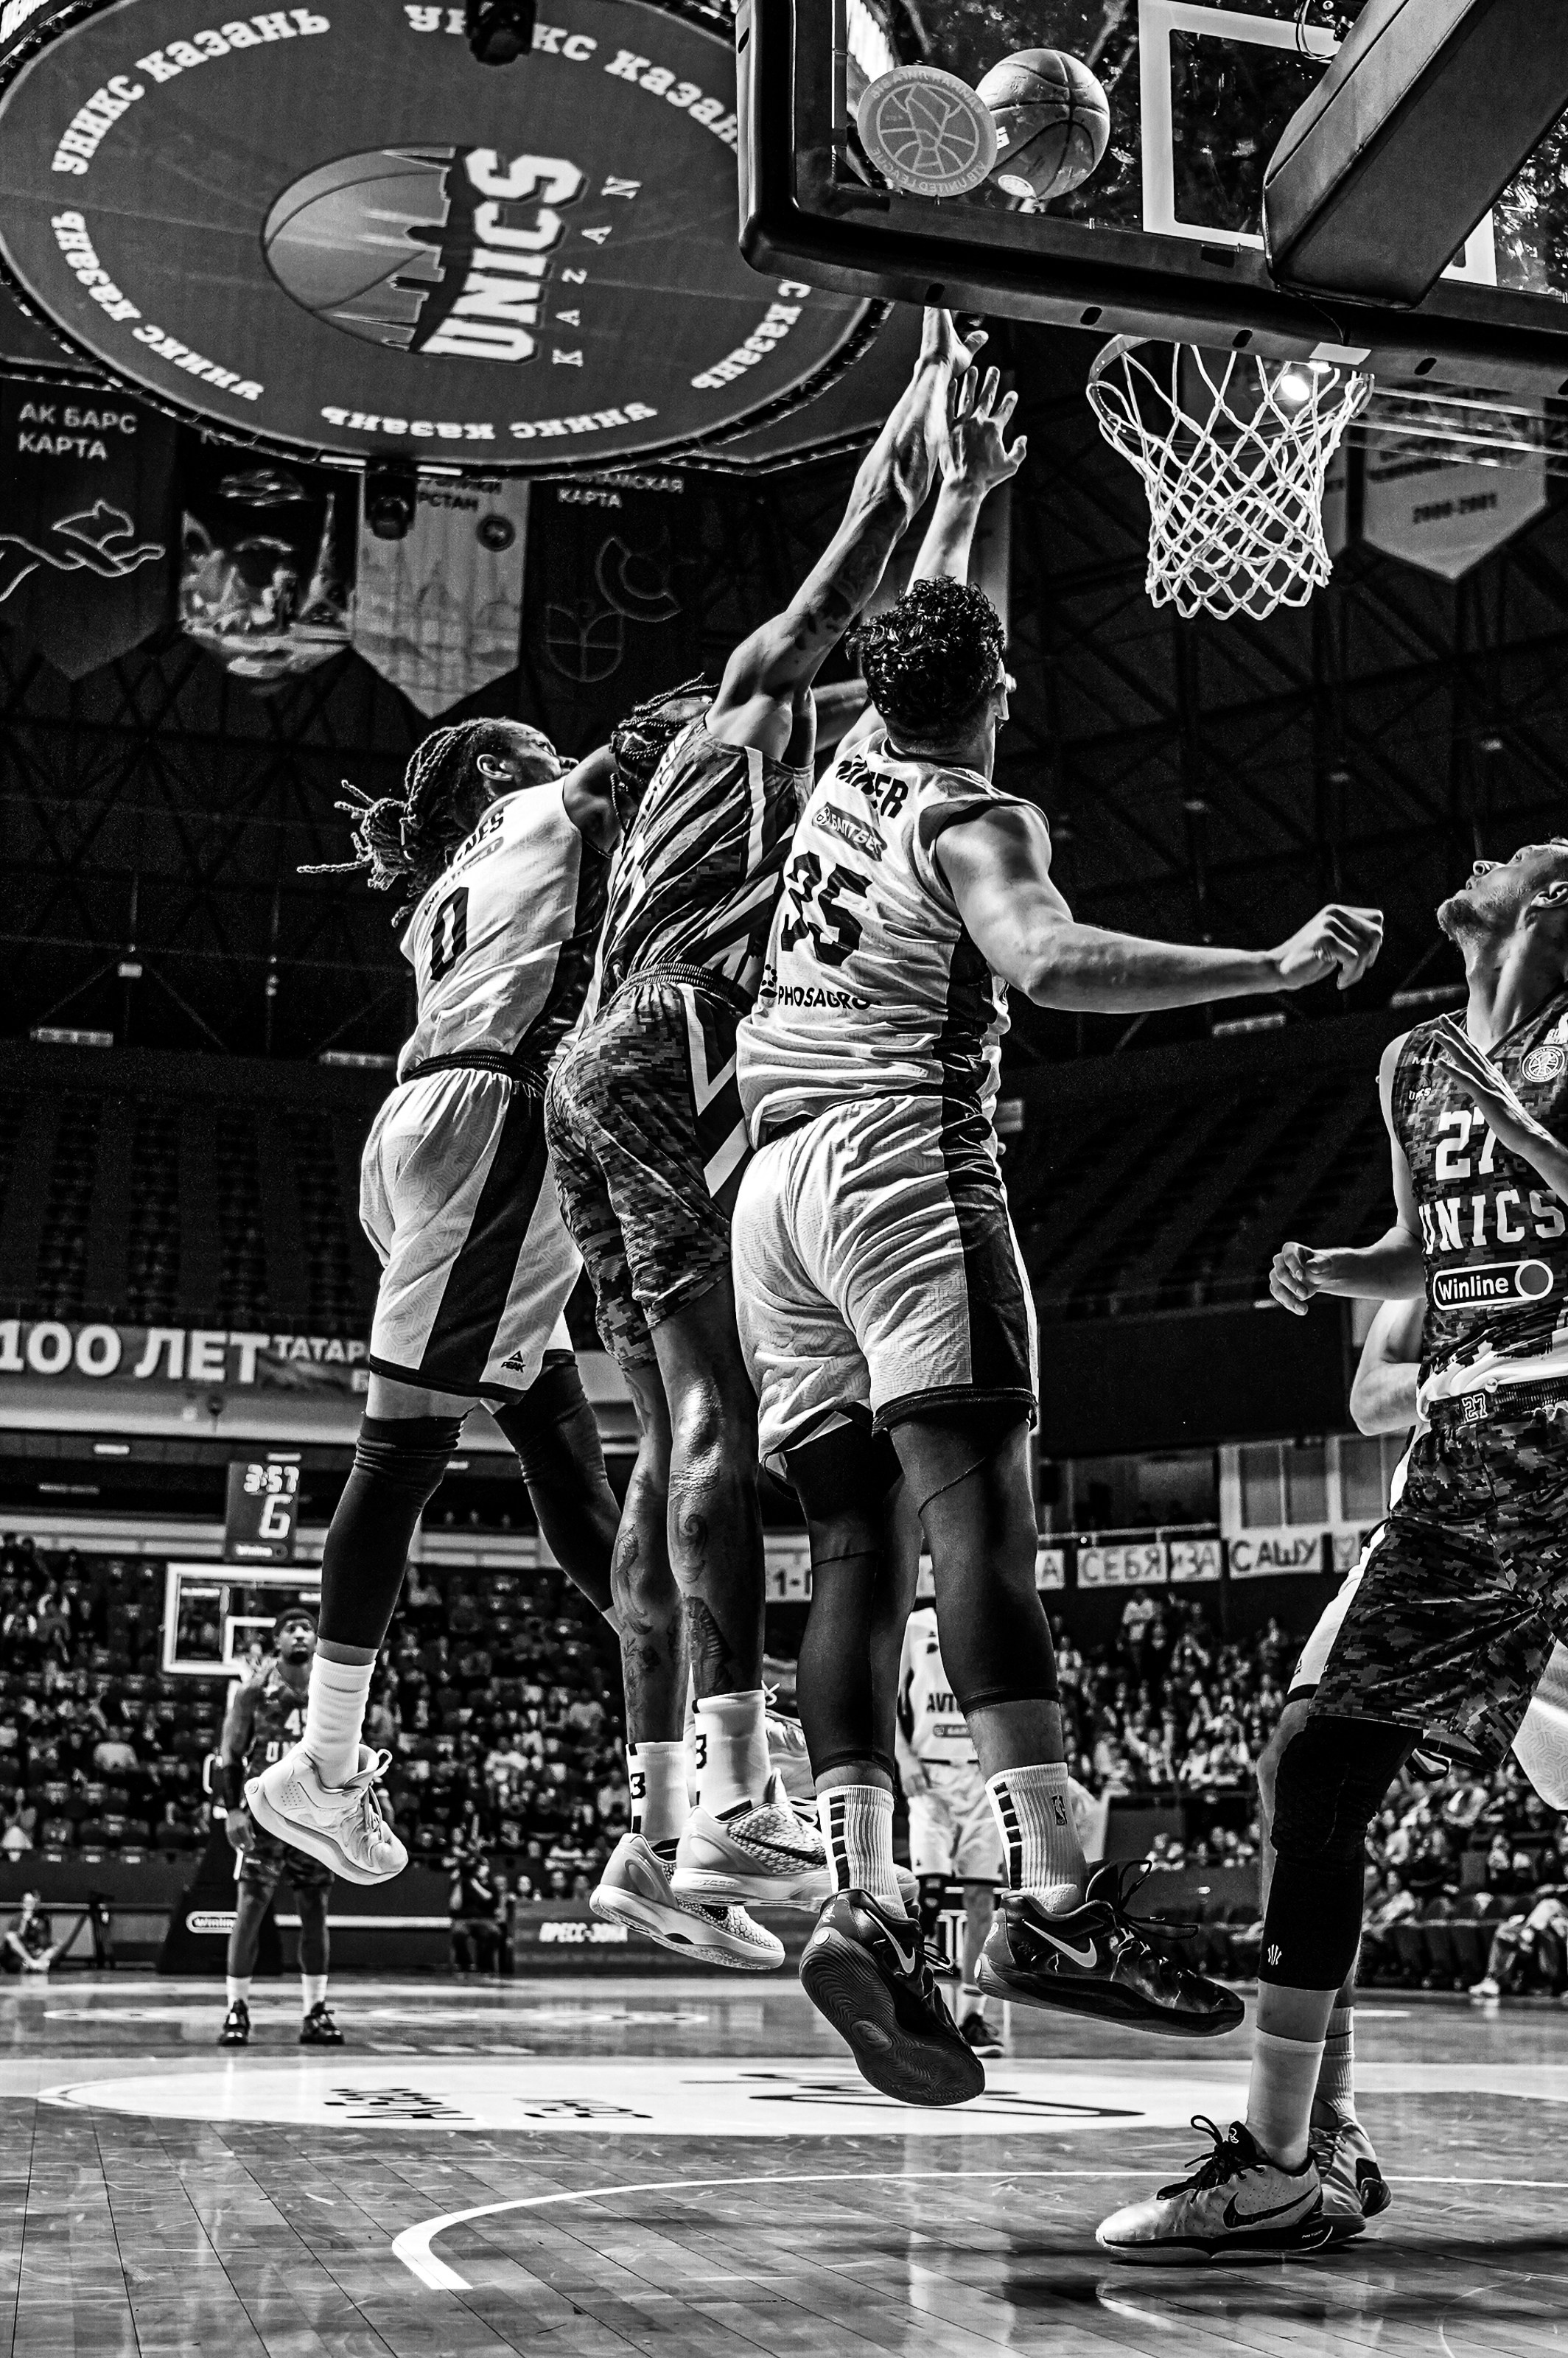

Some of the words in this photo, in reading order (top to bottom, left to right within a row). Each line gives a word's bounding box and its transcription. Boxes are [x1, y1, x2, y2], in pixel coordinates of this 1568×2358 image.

[421, 148, 582, 362] UNICS
[18, 402, 56, 424] АК
[63, 407, 139, 435] БАРС
[18, 432, 108, 461] КАРТА
[429, 886, 469, 982] 0
[777, 985, 871, 1010] PHOSAGRO
[1418, 1189, 1566, 1254] UNICS
[1438, 1276, 1509, 1301] Winline
[0, 1320, 122, 1376] 100
[133, 1328, 270, 1384] ЛЕТ
[273, 1334, 370, 1363] ТАТАР
[1462, 1393, 1488, 1423] 27
[258, 1493, 293, 1539] 6
[1082, 1547, 1163, 1582] СЕБЯ
[1229, 1538, 1317, 1572] САШУ
[926, 1693, 961, 1712] AVT
[630, 1771, 646, 1800] 3
